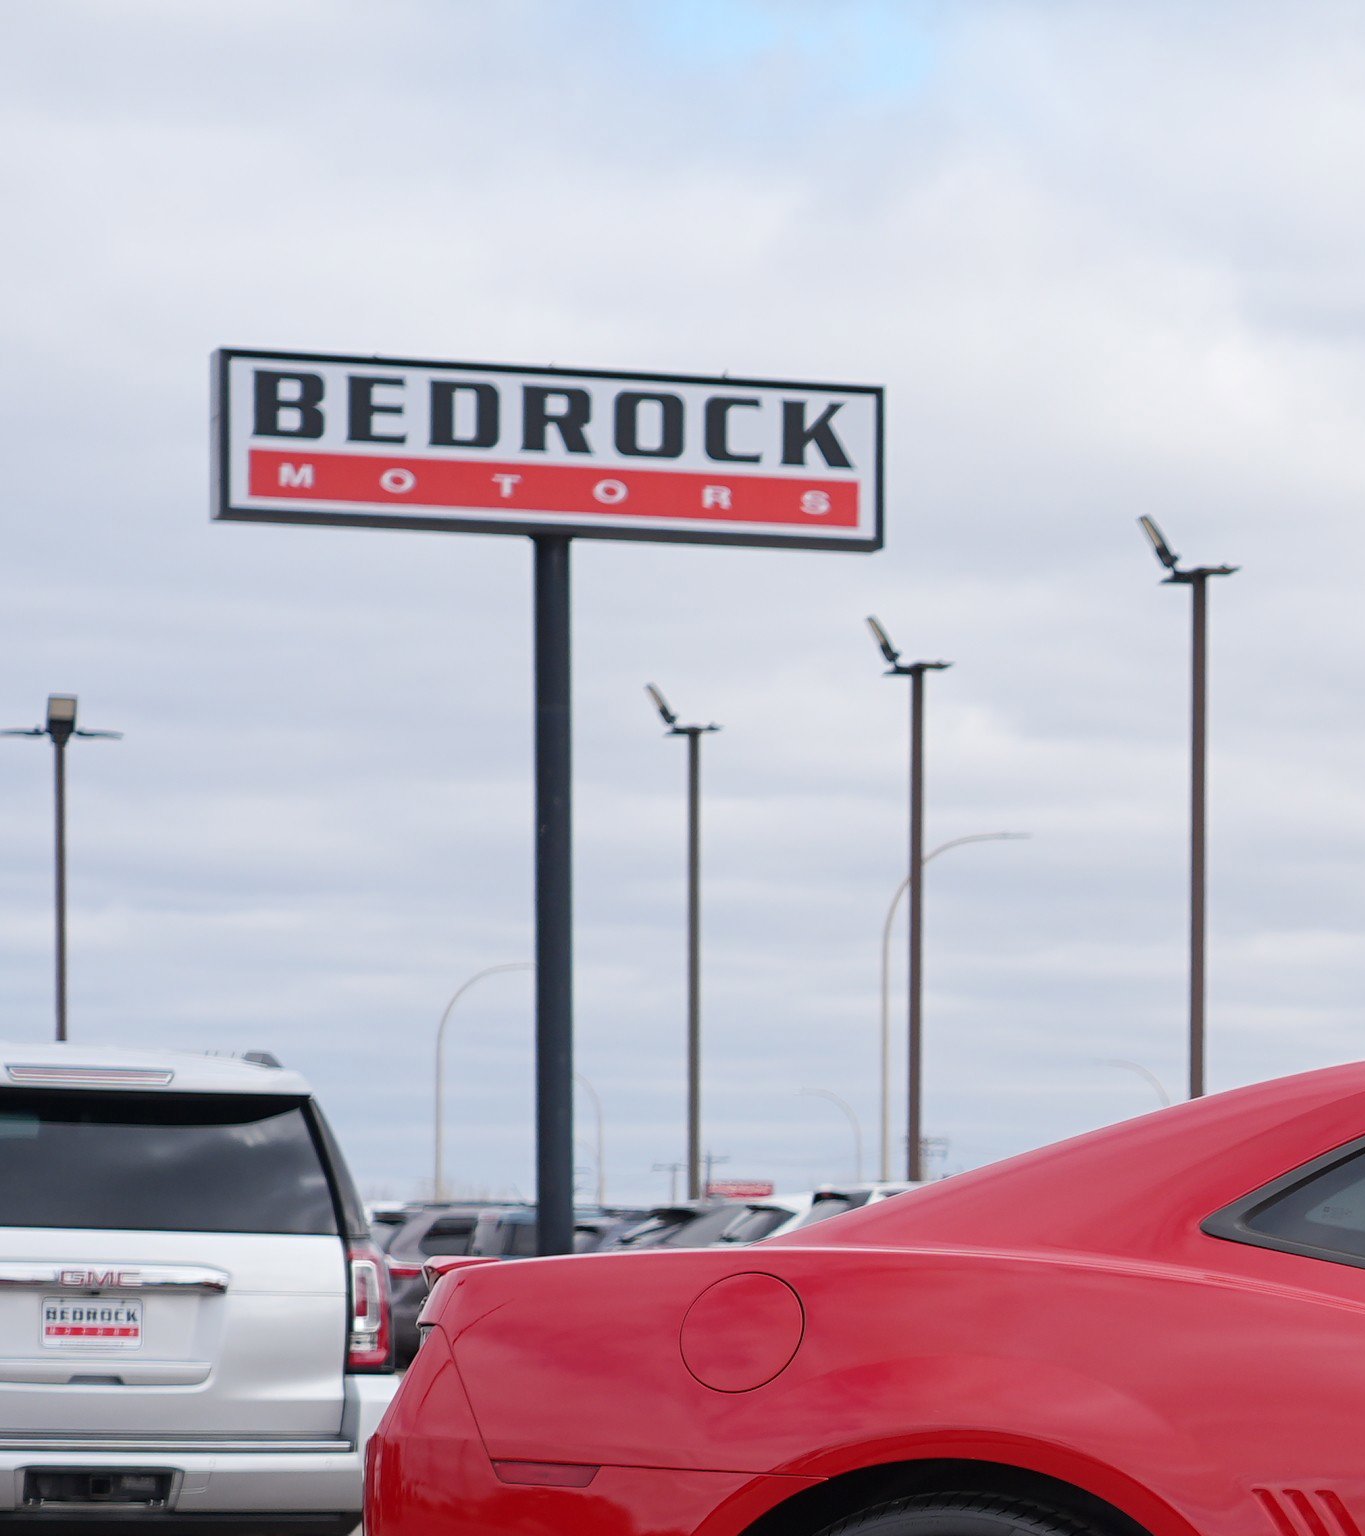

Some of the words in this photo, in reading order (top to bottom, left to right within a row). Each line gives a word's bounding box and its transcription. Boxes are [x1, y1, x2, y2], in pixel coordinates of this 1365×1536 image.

[251, 368, 856, 469] BEDROCK
[278, 462, 832, 516] MOTORS
[59, 1269, 143, 1288] GMC
[45, 1307, 139, 1323] BEDROCK
